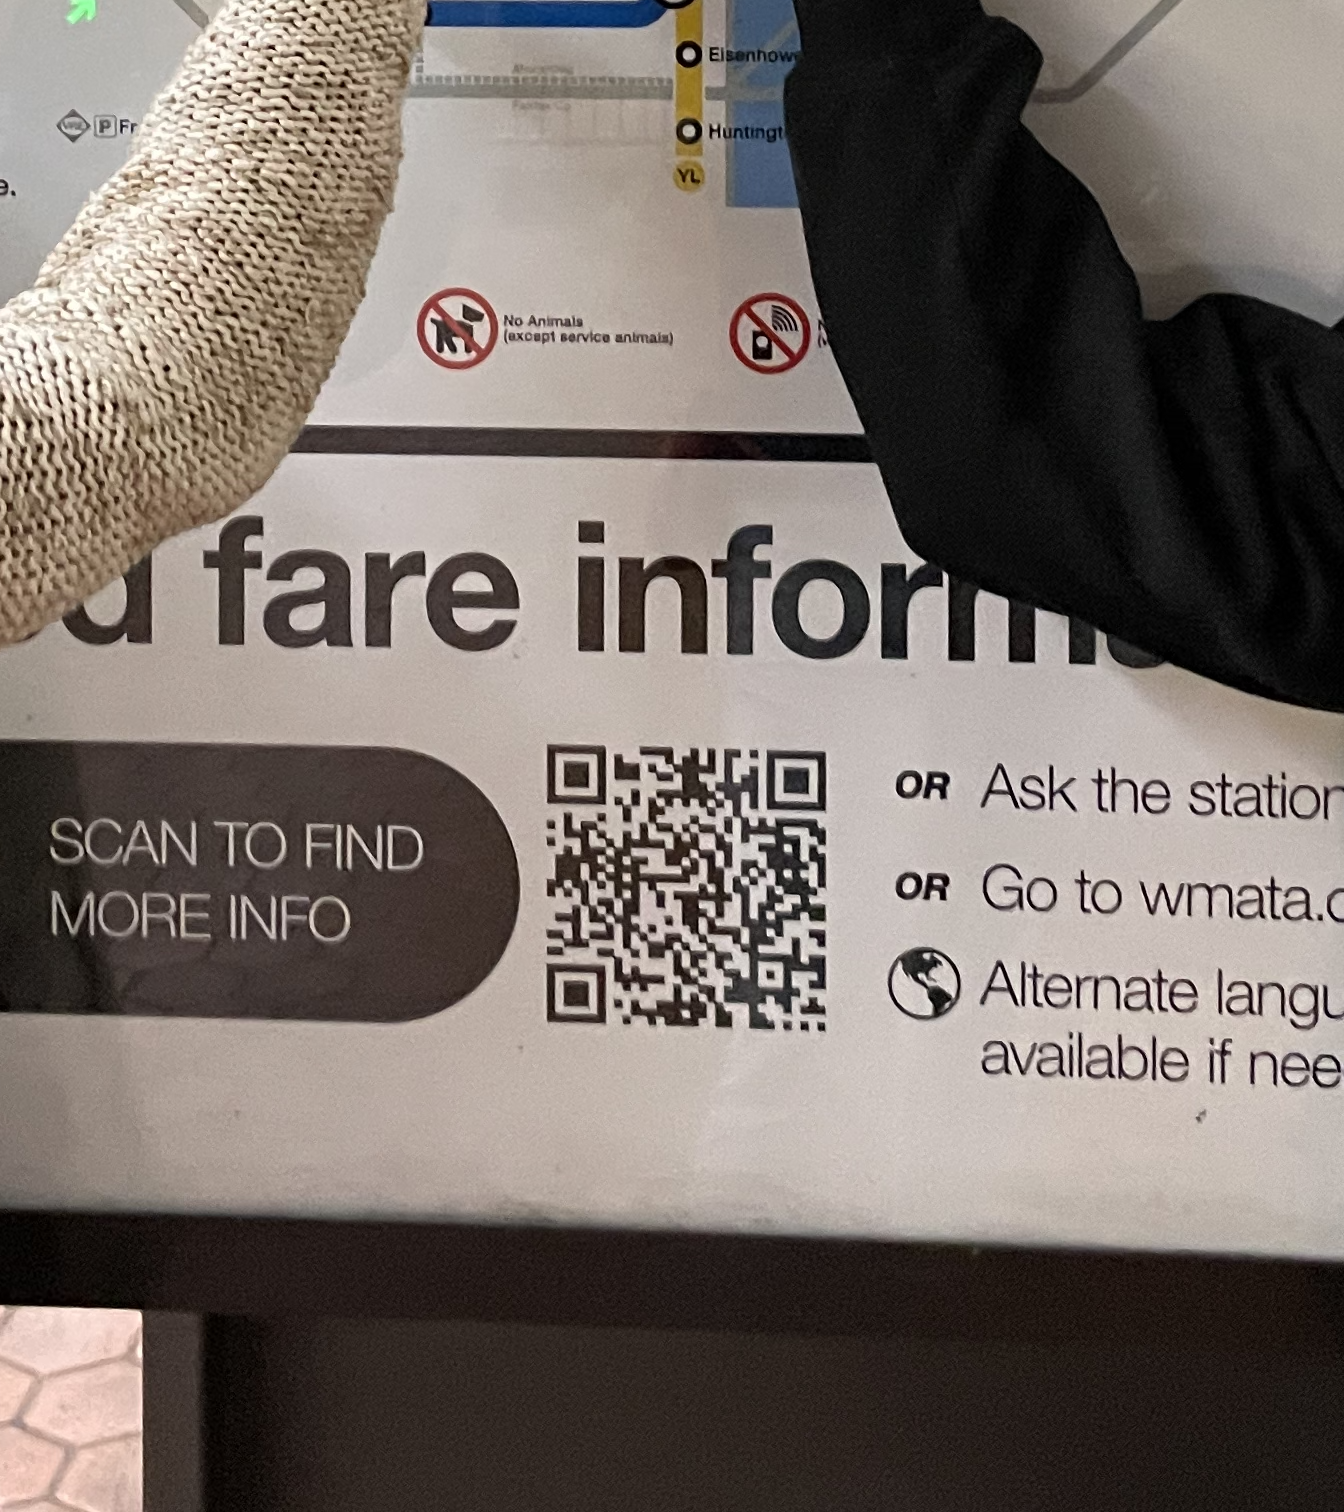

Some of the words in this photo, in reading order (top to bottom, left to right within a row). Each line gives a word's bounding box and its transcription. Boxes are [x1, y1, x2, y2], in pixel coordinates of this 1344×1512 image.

[709, 125, 784, 143] Huntingt
[677, 170, 700, 184] YL
[503, 330, 556, 345] (except
[560, 331, 610, 344] service
[615, 330, 674, 346] animals)
[504, 315, 524, 327] No
[528, 315, 583, 328] Animals
[203, 516, 520, 652] fare
[895, 771, 950, 801] OR
[980, 763, 1078, 812] Ask
[1091, 767, 1171, 815] the
[50, 817, 197, 866] SCAN
[213, 821, 287, 869] TO
[305, 823, 424, 872] FIND
[895, 873, 950, 902] OR
[982, 864, 1057, 912] Go
[1075, 870, 1122, 915] to
[51, 890, 212, 940] MORE
[230, 894, 351, 943] INFO
[980, 960, 1198, 1014] Alternate
[981, 1032, 1189, 1084] available
[1209, 1037, 1233, 1084] if
